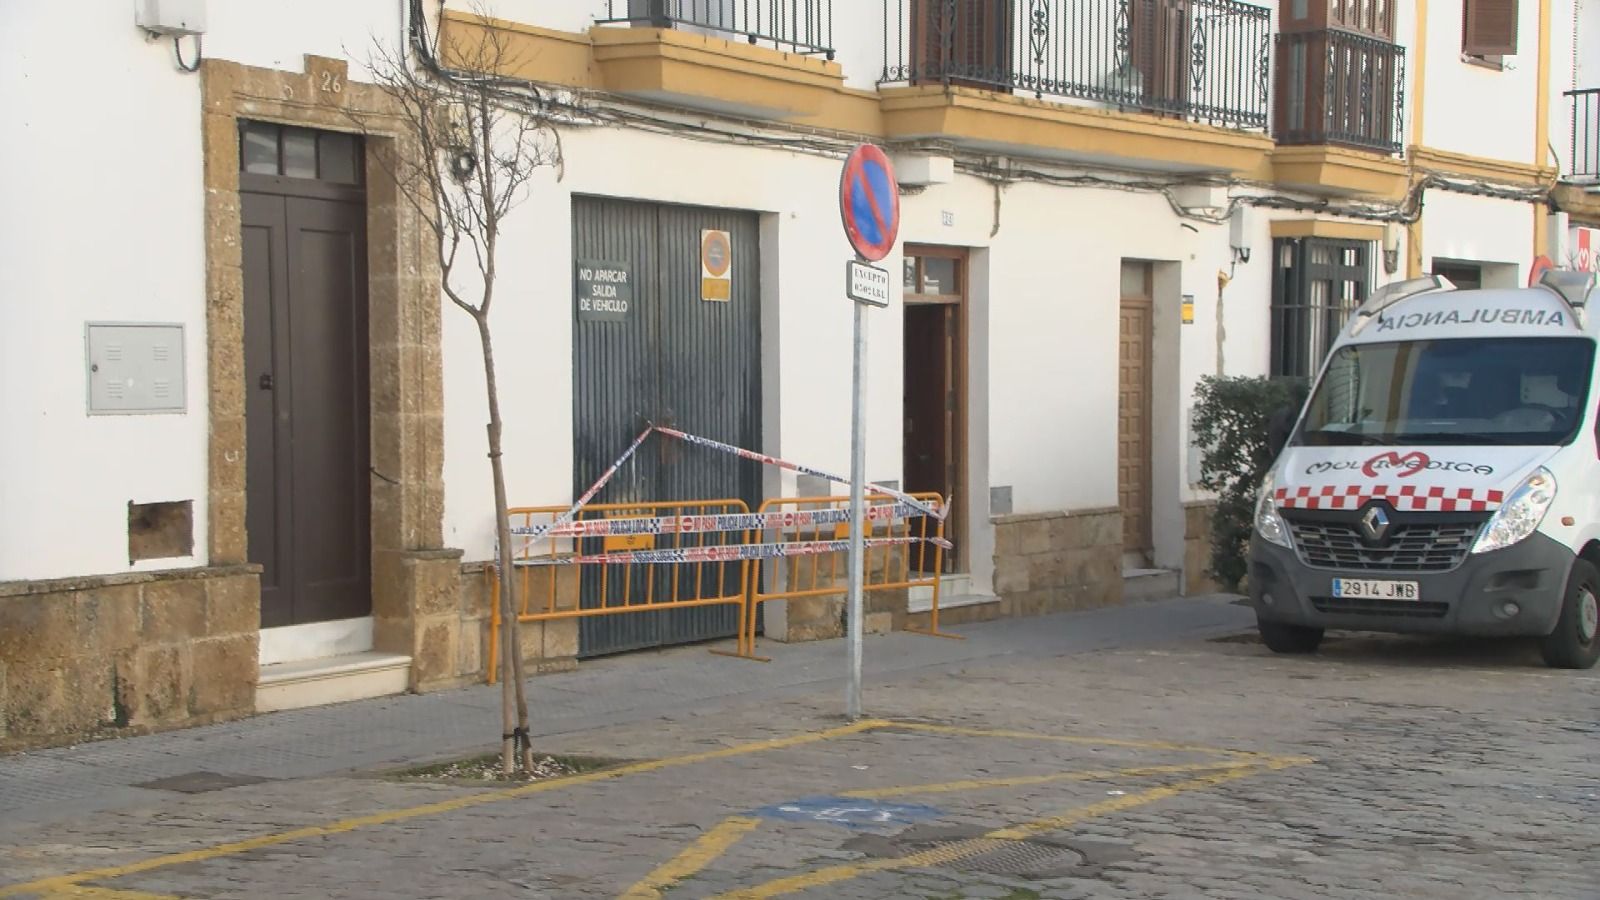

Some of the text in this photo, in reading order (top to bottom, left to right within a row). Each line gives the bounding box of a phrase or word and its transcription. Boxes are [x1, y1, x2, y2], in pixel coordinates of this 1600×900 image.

[321, 70, 342, 93] 26
[580, 269, 627, 283] NO APARCAR
[854, 267, 887, 284] EXCEPTO
[592, 284, 617, 298] SALIDA
[580, 298, 628, 313] DE VEHICULO
[632, 518, 649, 534] LOCAL
[702, 516, 717, 531] PASAR
[718, 515, 738, 530] POLICIA
[739, 514, 755, 529] LOCAL
[1343, 581, 1380, 596] 2914
[1386, 583, 1416, 598] JWB
